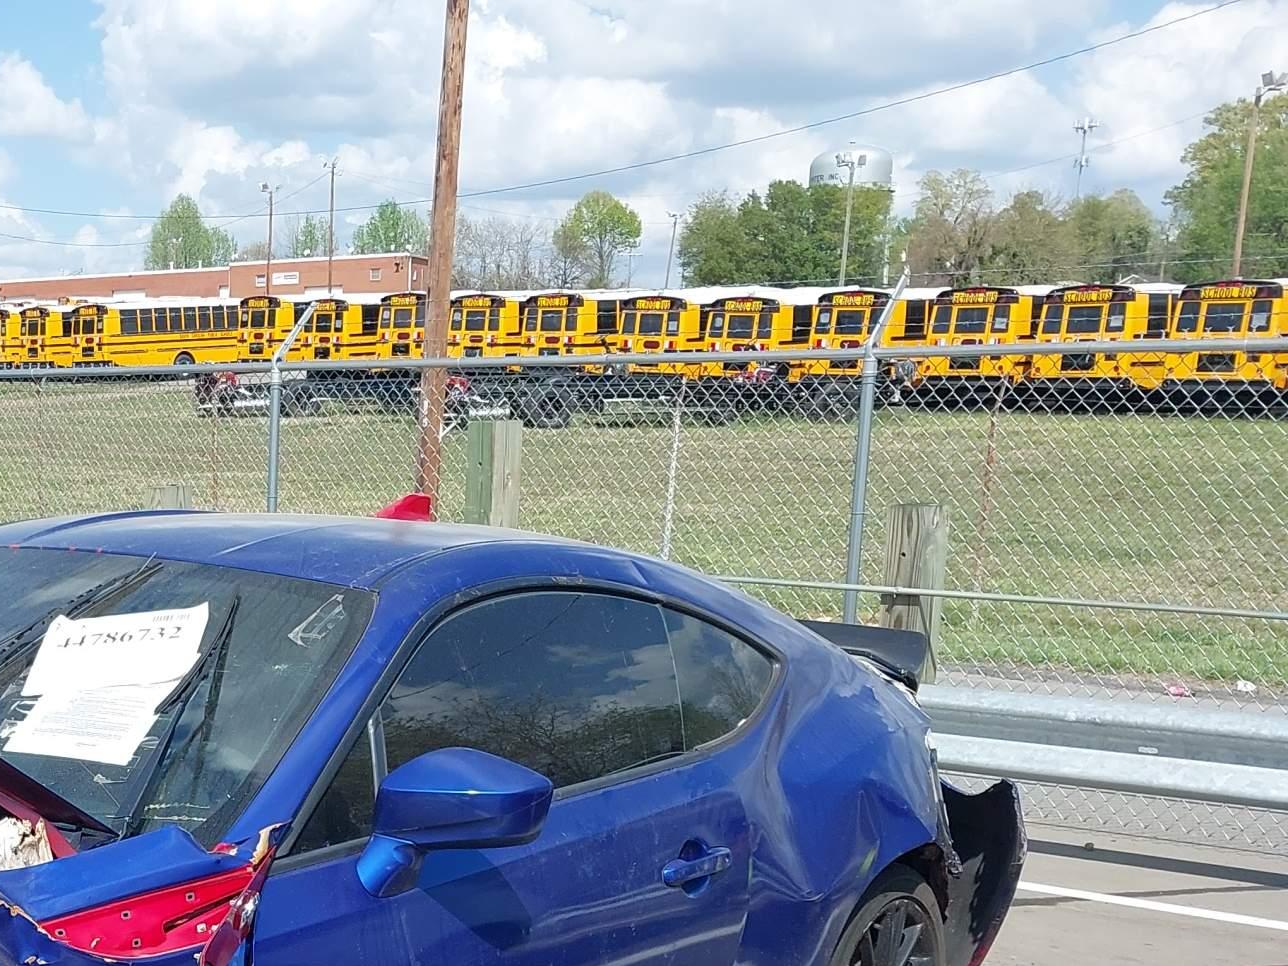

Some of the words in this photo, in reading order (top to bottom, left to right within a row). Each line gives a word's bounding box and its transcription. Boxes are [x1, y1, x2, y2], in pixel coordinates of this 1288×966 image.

[1098, 289, 1112, 301] BUS
[1203, 287, 1235, 299] SCHOOL
[1238, 286, 1256, 298] BUS
[56, 626, 182, 648] 44786732
